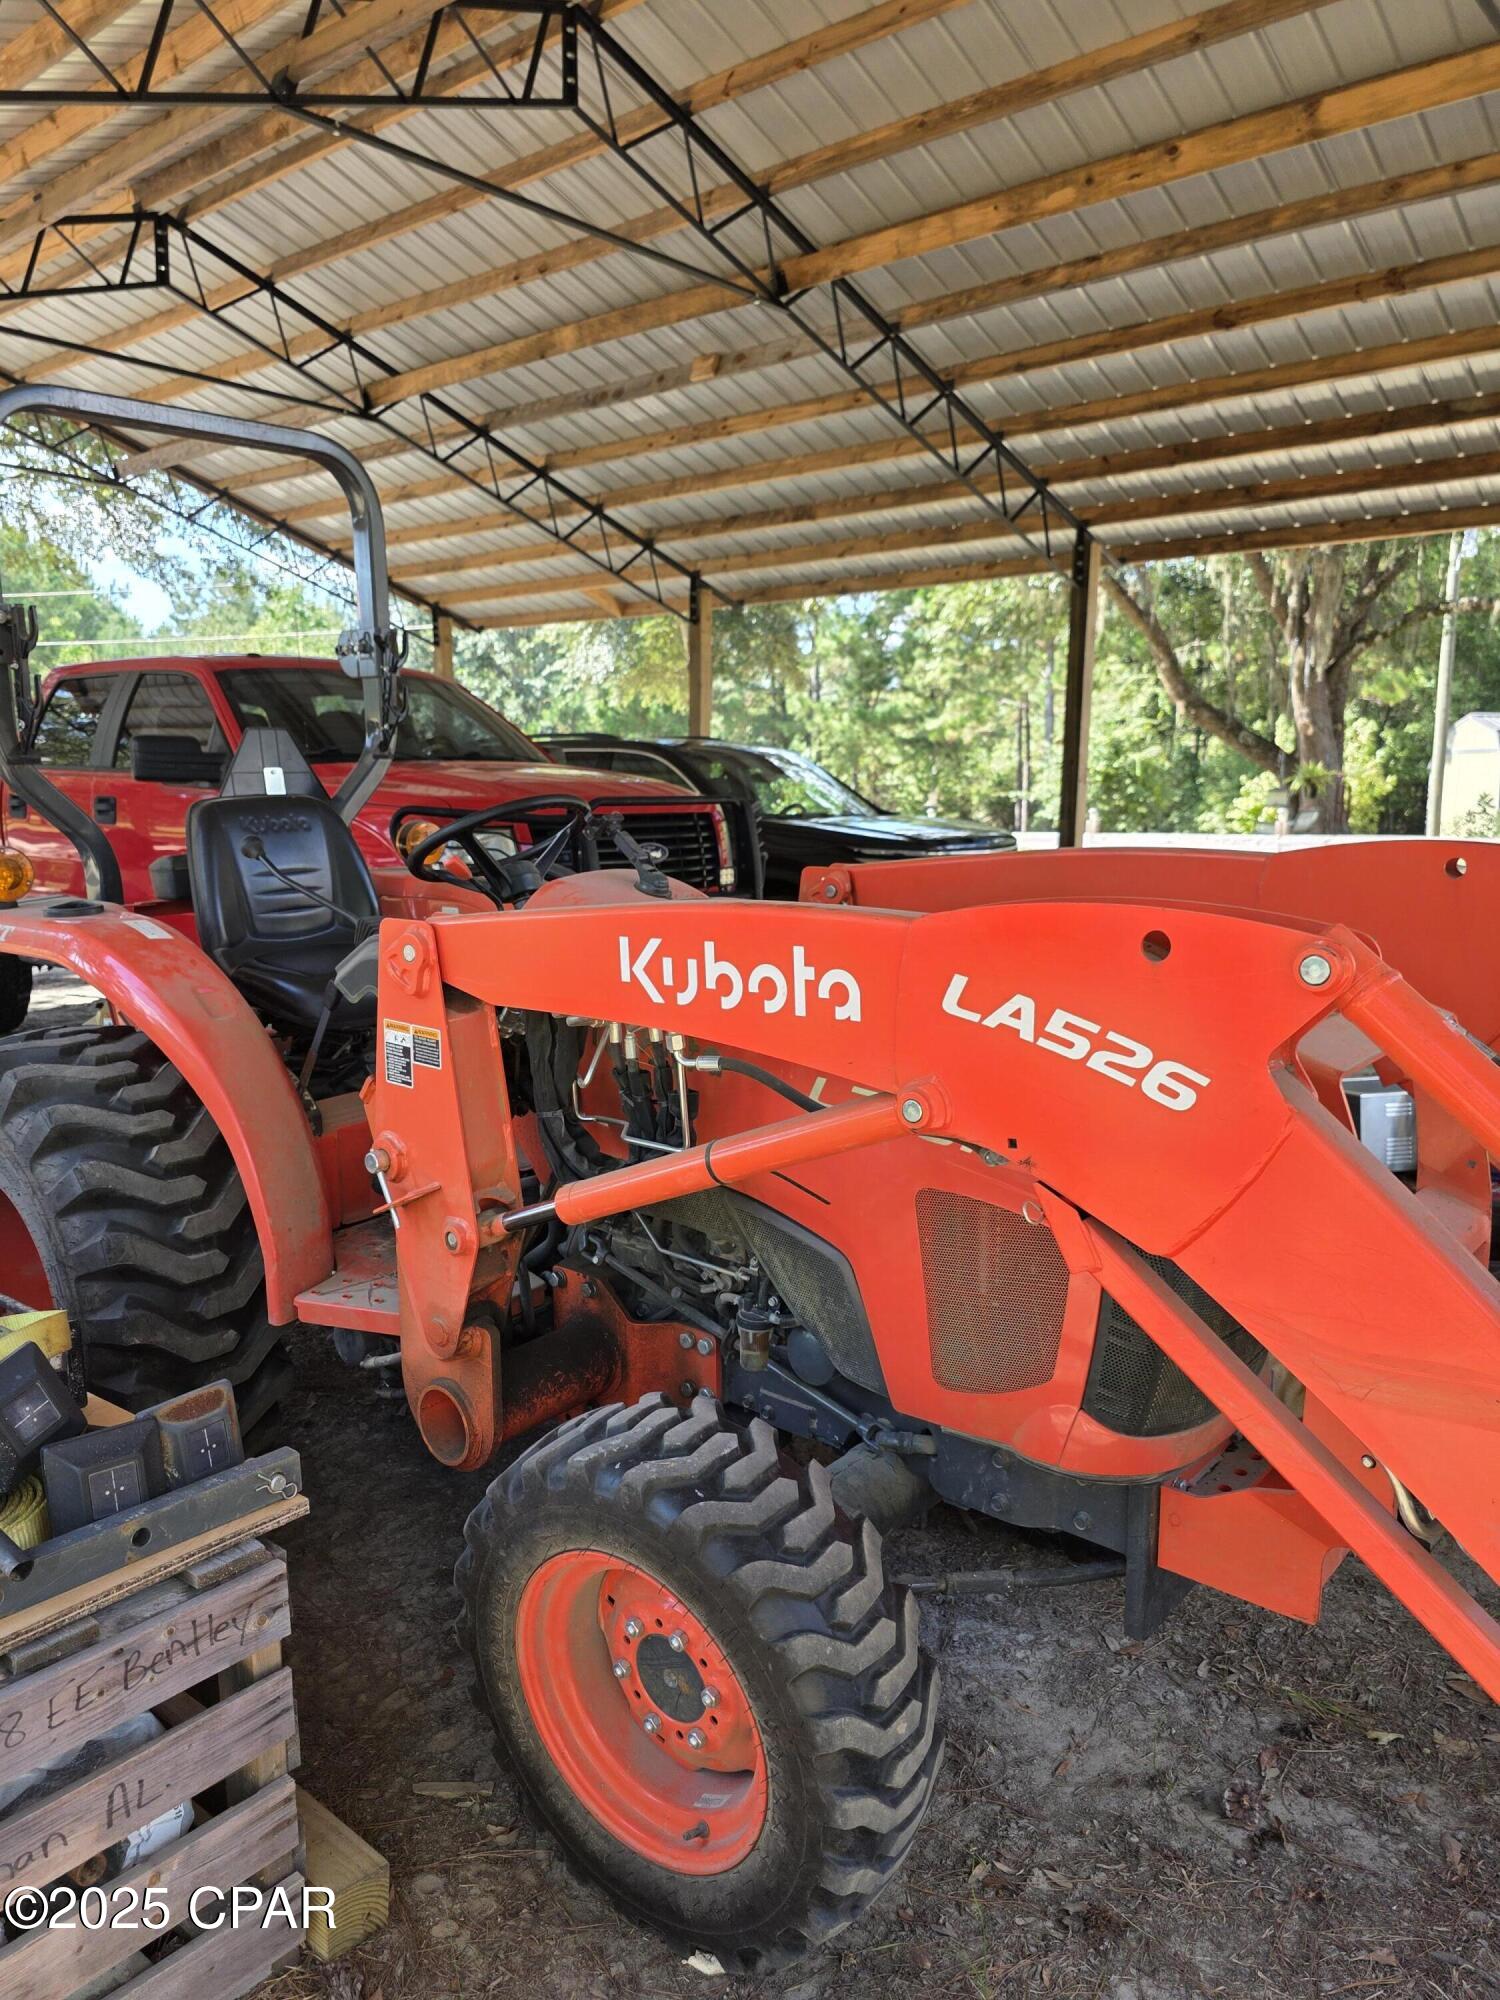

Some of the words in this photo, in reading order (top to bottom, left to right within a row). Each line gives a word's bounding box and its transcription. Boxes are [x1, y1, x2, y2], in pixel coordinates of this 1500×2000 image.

[618, 935, 862, 1023] Kubota
[941, 972, 1212, 1112] LA526
[123, 1601, 254, 1691] Bentley
